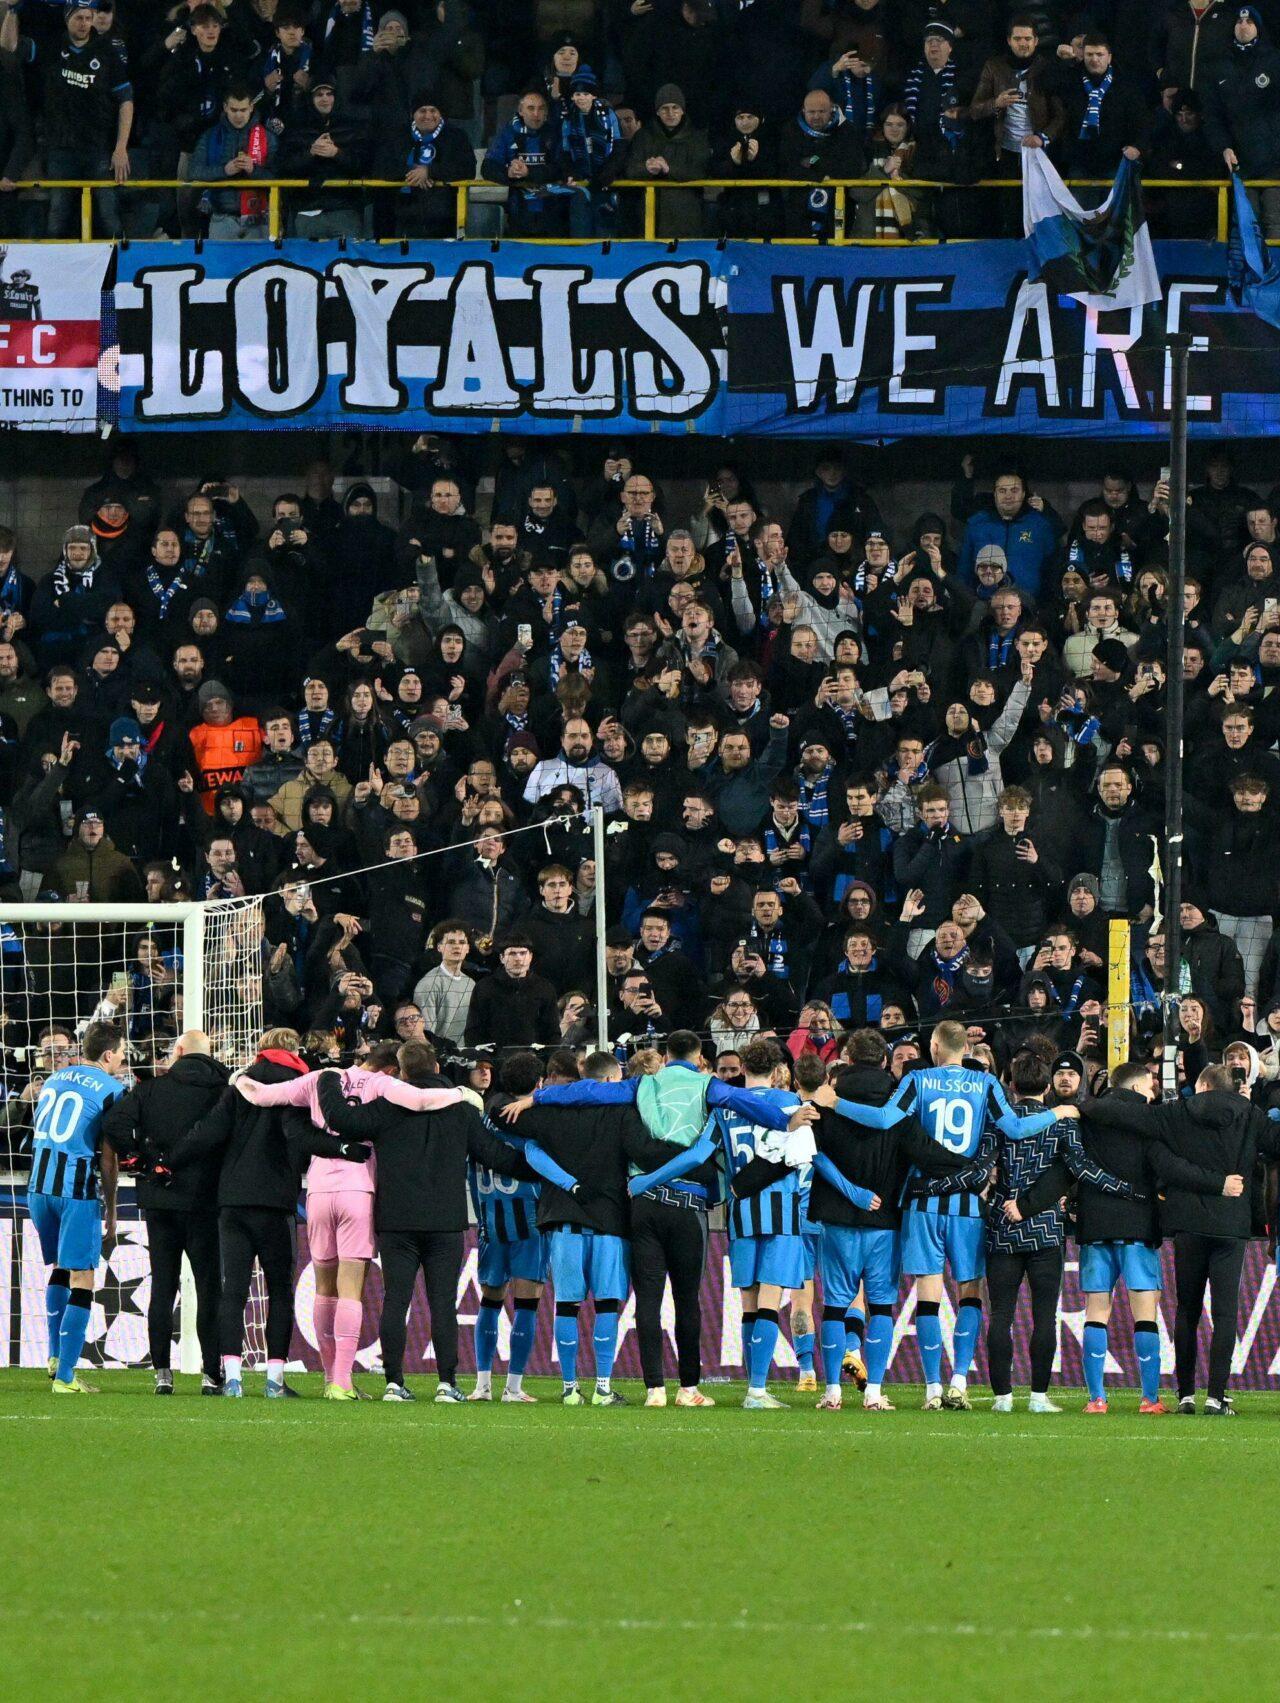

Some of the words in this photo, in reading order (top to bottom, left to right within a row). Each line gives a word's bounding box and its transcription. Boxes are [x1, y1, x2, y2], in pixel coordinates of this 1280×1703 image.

[61, 68, 96, 84] UNIBET
[138, 261, 719, 420] LOYALS
[781, 283, 943, 407] WE
[994, 280, 1218, 410] ARE
[0, 389, 53, 407] THING
[61, 389, 84, 407] TO
[922, 1077, 983, 1093] NILSSON
[34, 1087, 84, 1143] 20
[929, 1098, 974, 1154] 19
